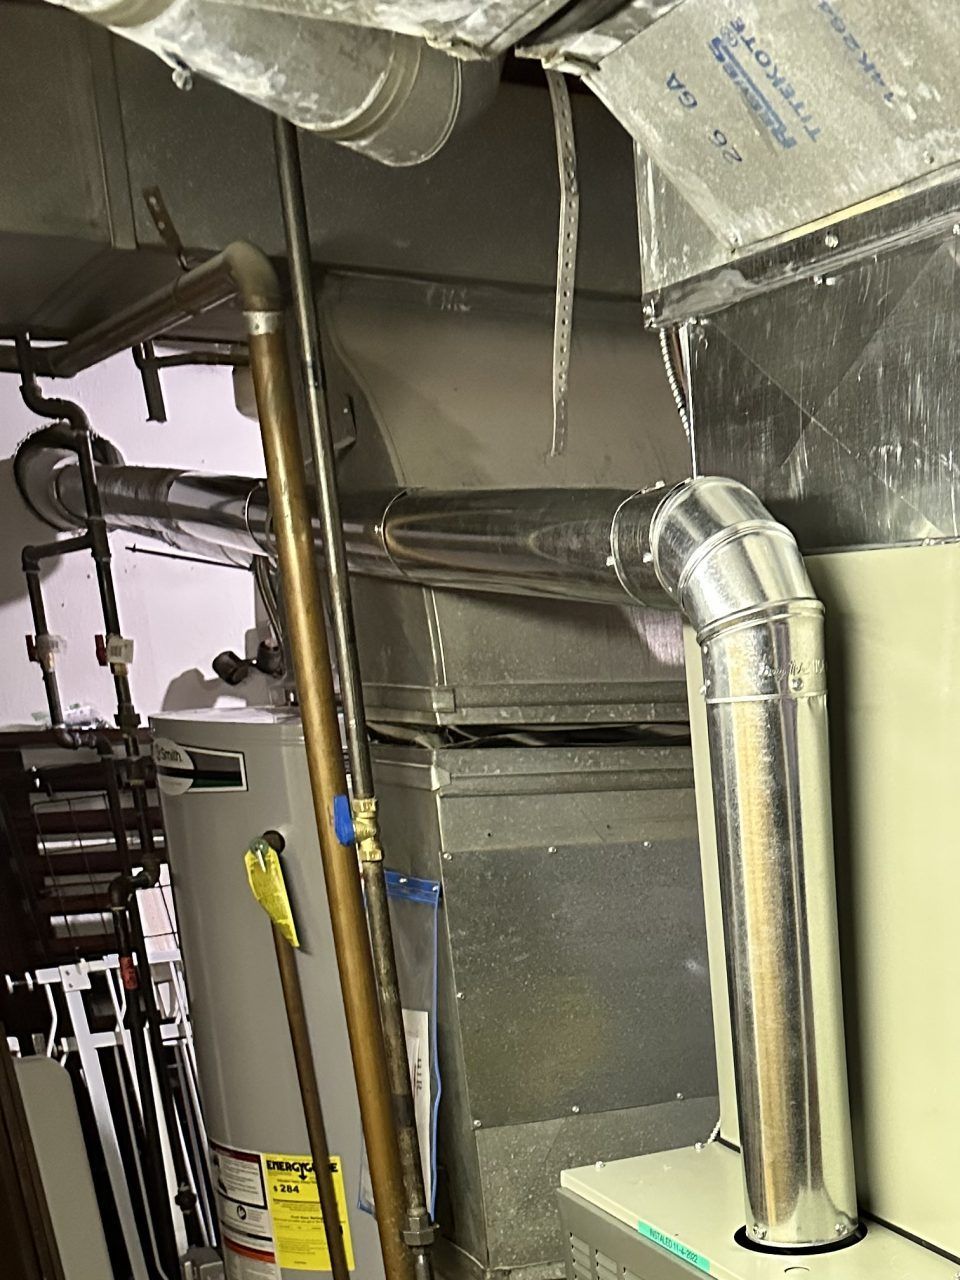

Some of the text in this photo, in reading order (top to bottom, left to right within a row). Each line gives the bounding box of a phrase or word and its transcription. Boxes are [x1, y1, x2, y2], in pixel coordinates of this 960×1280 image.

[729, 16, 821, 143] TITEKOTE
[666, 72, 743, 165] 26 GA
[266, 1160, 339, 1173] ENERGYGE
[280, 1184, 300, 1194] 284
